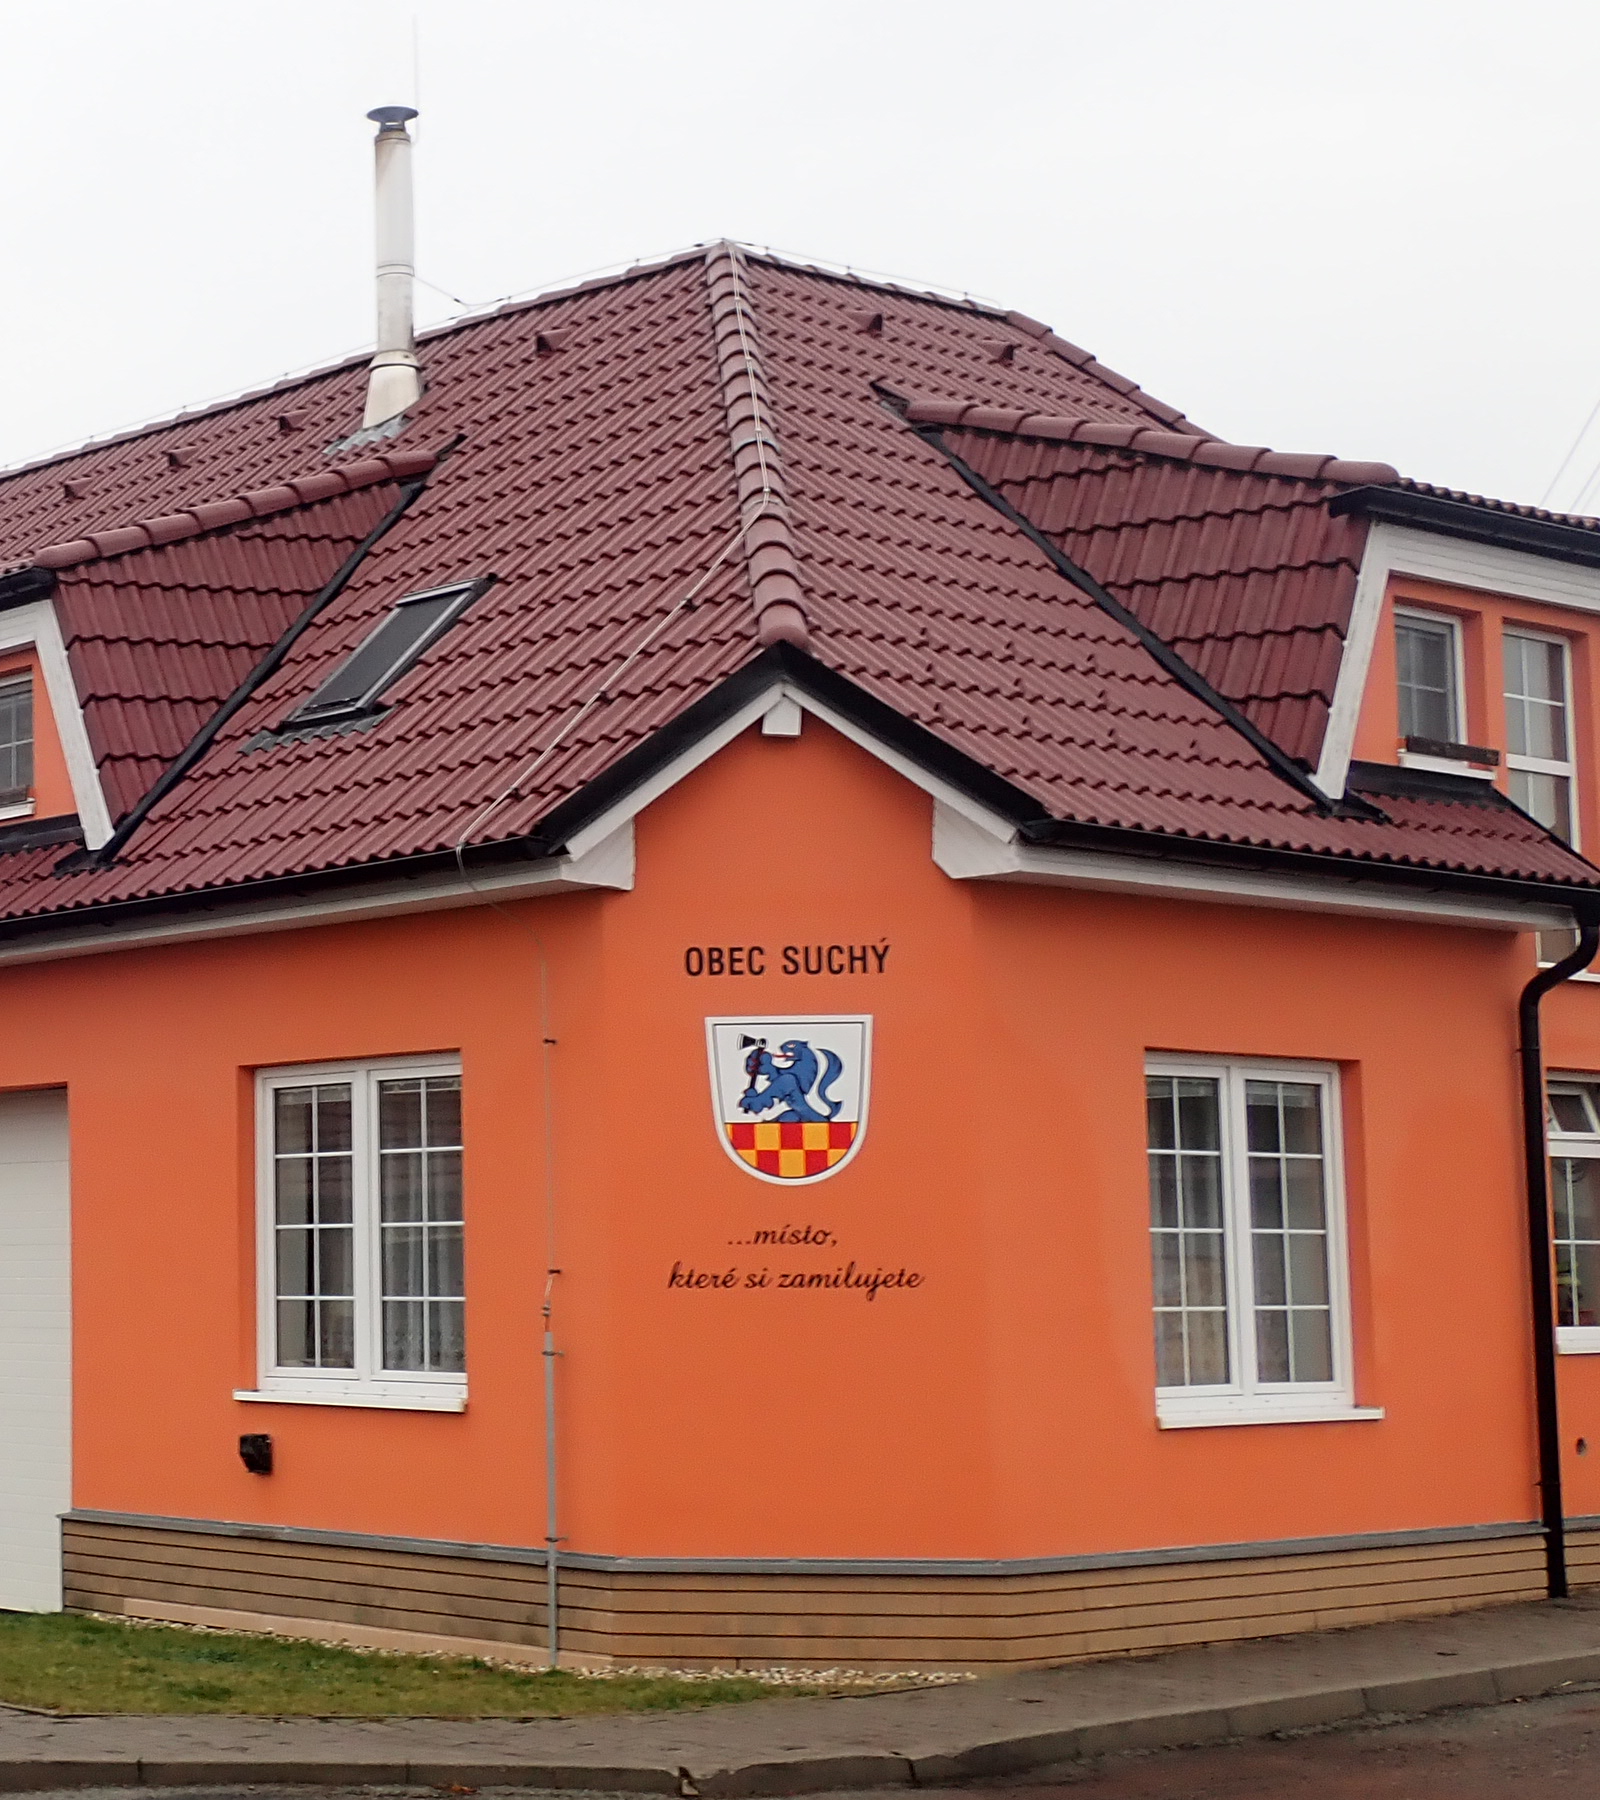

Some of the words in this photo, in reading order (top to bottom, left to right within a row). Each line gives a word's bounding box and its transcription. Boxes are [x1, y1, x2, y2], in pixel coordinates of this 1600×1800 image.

[685, 946, 765, 976] OBEC
[781, 938, 891, 975] SUCHÝ
[668, 1261, 738, 1289] které
[744, 1267, 773, 1289] si
[777, 1261, 925, 1301] zamilujete
